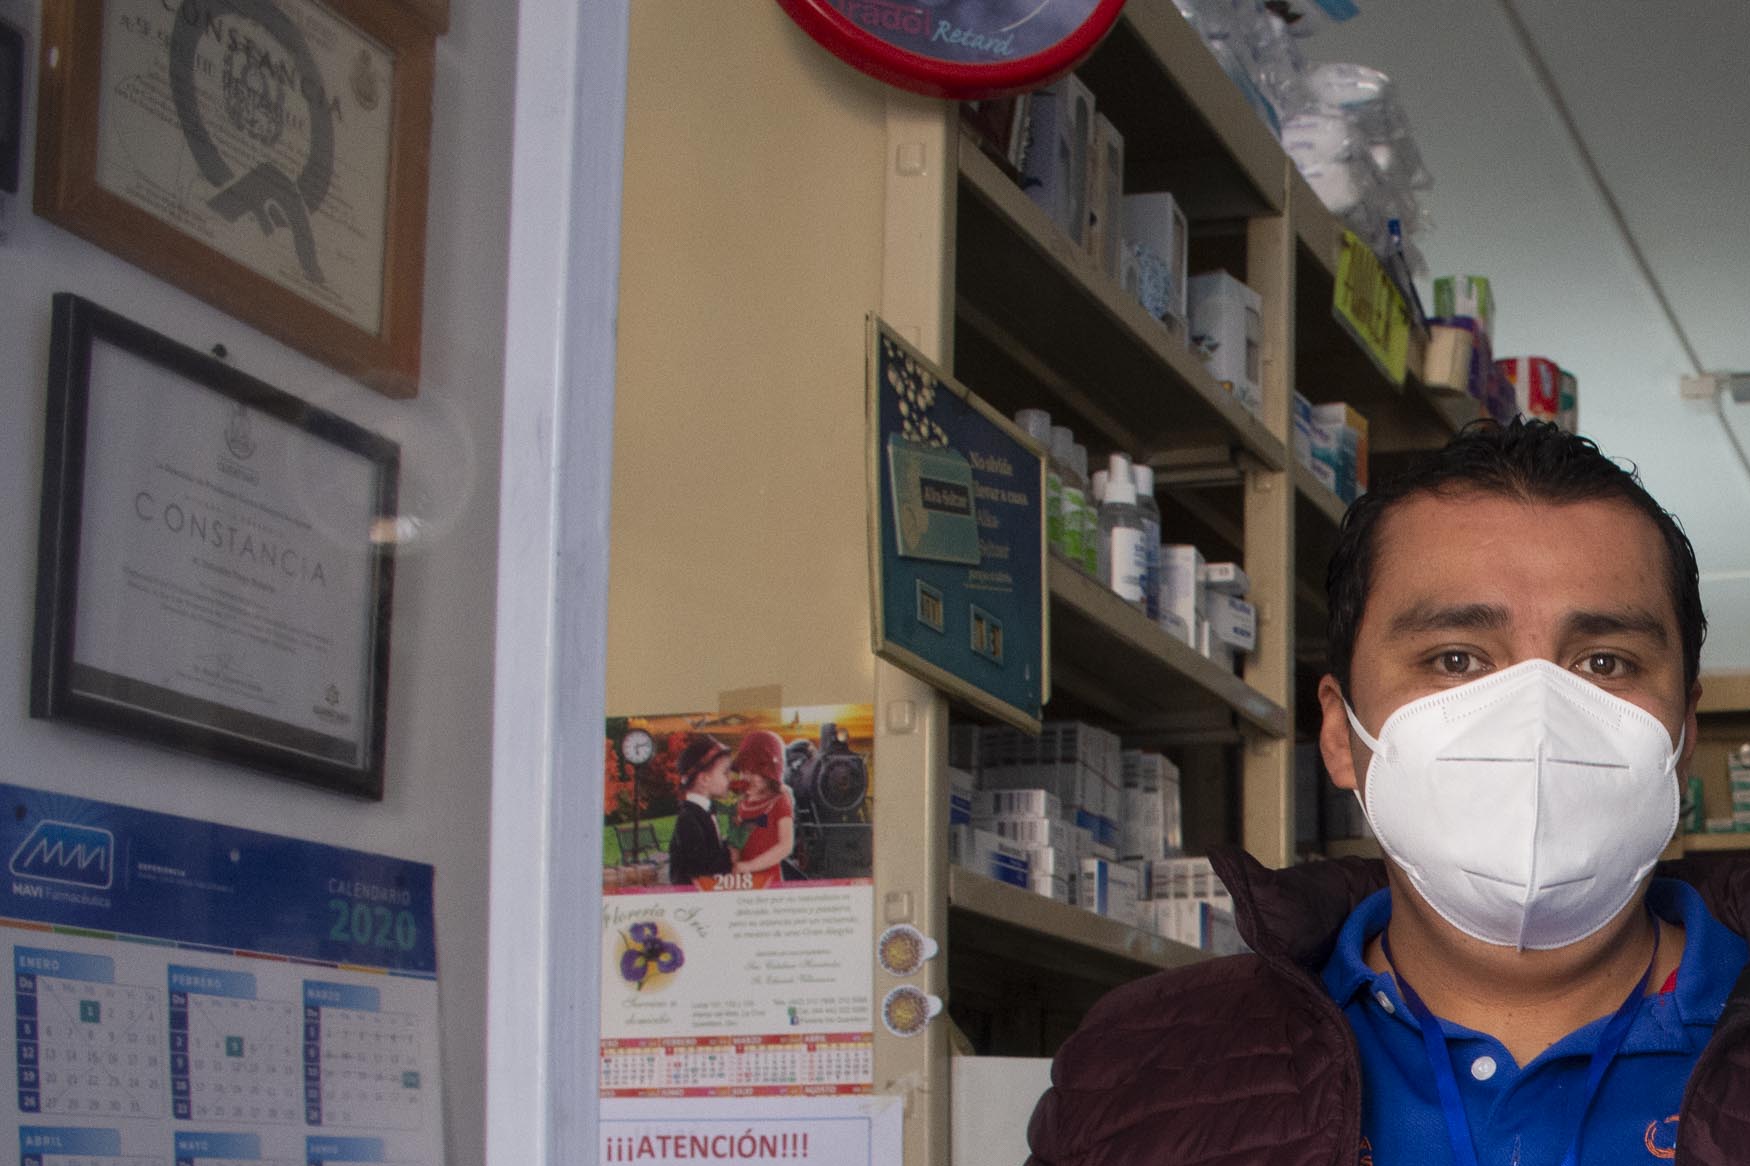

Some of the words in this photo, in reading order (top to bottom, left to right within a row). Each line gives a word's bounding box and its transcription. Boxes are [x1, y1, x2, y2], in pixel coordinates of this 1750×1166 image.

[932, 20, 1014, 56] Retard
[135, 491, 327, 587] CONSTANCIA
[328, 877, 411, 906] CALENDARIO
[713, 873, 753, 891] 2018
[328, 898, 417, 951] 2020
[19, 955, 60, 971] ENERO
[25, 1135, 63, 1148] ABRIL
[606, 1128, 809, 1162] ¡¡¡ATENCIÓN!!!
